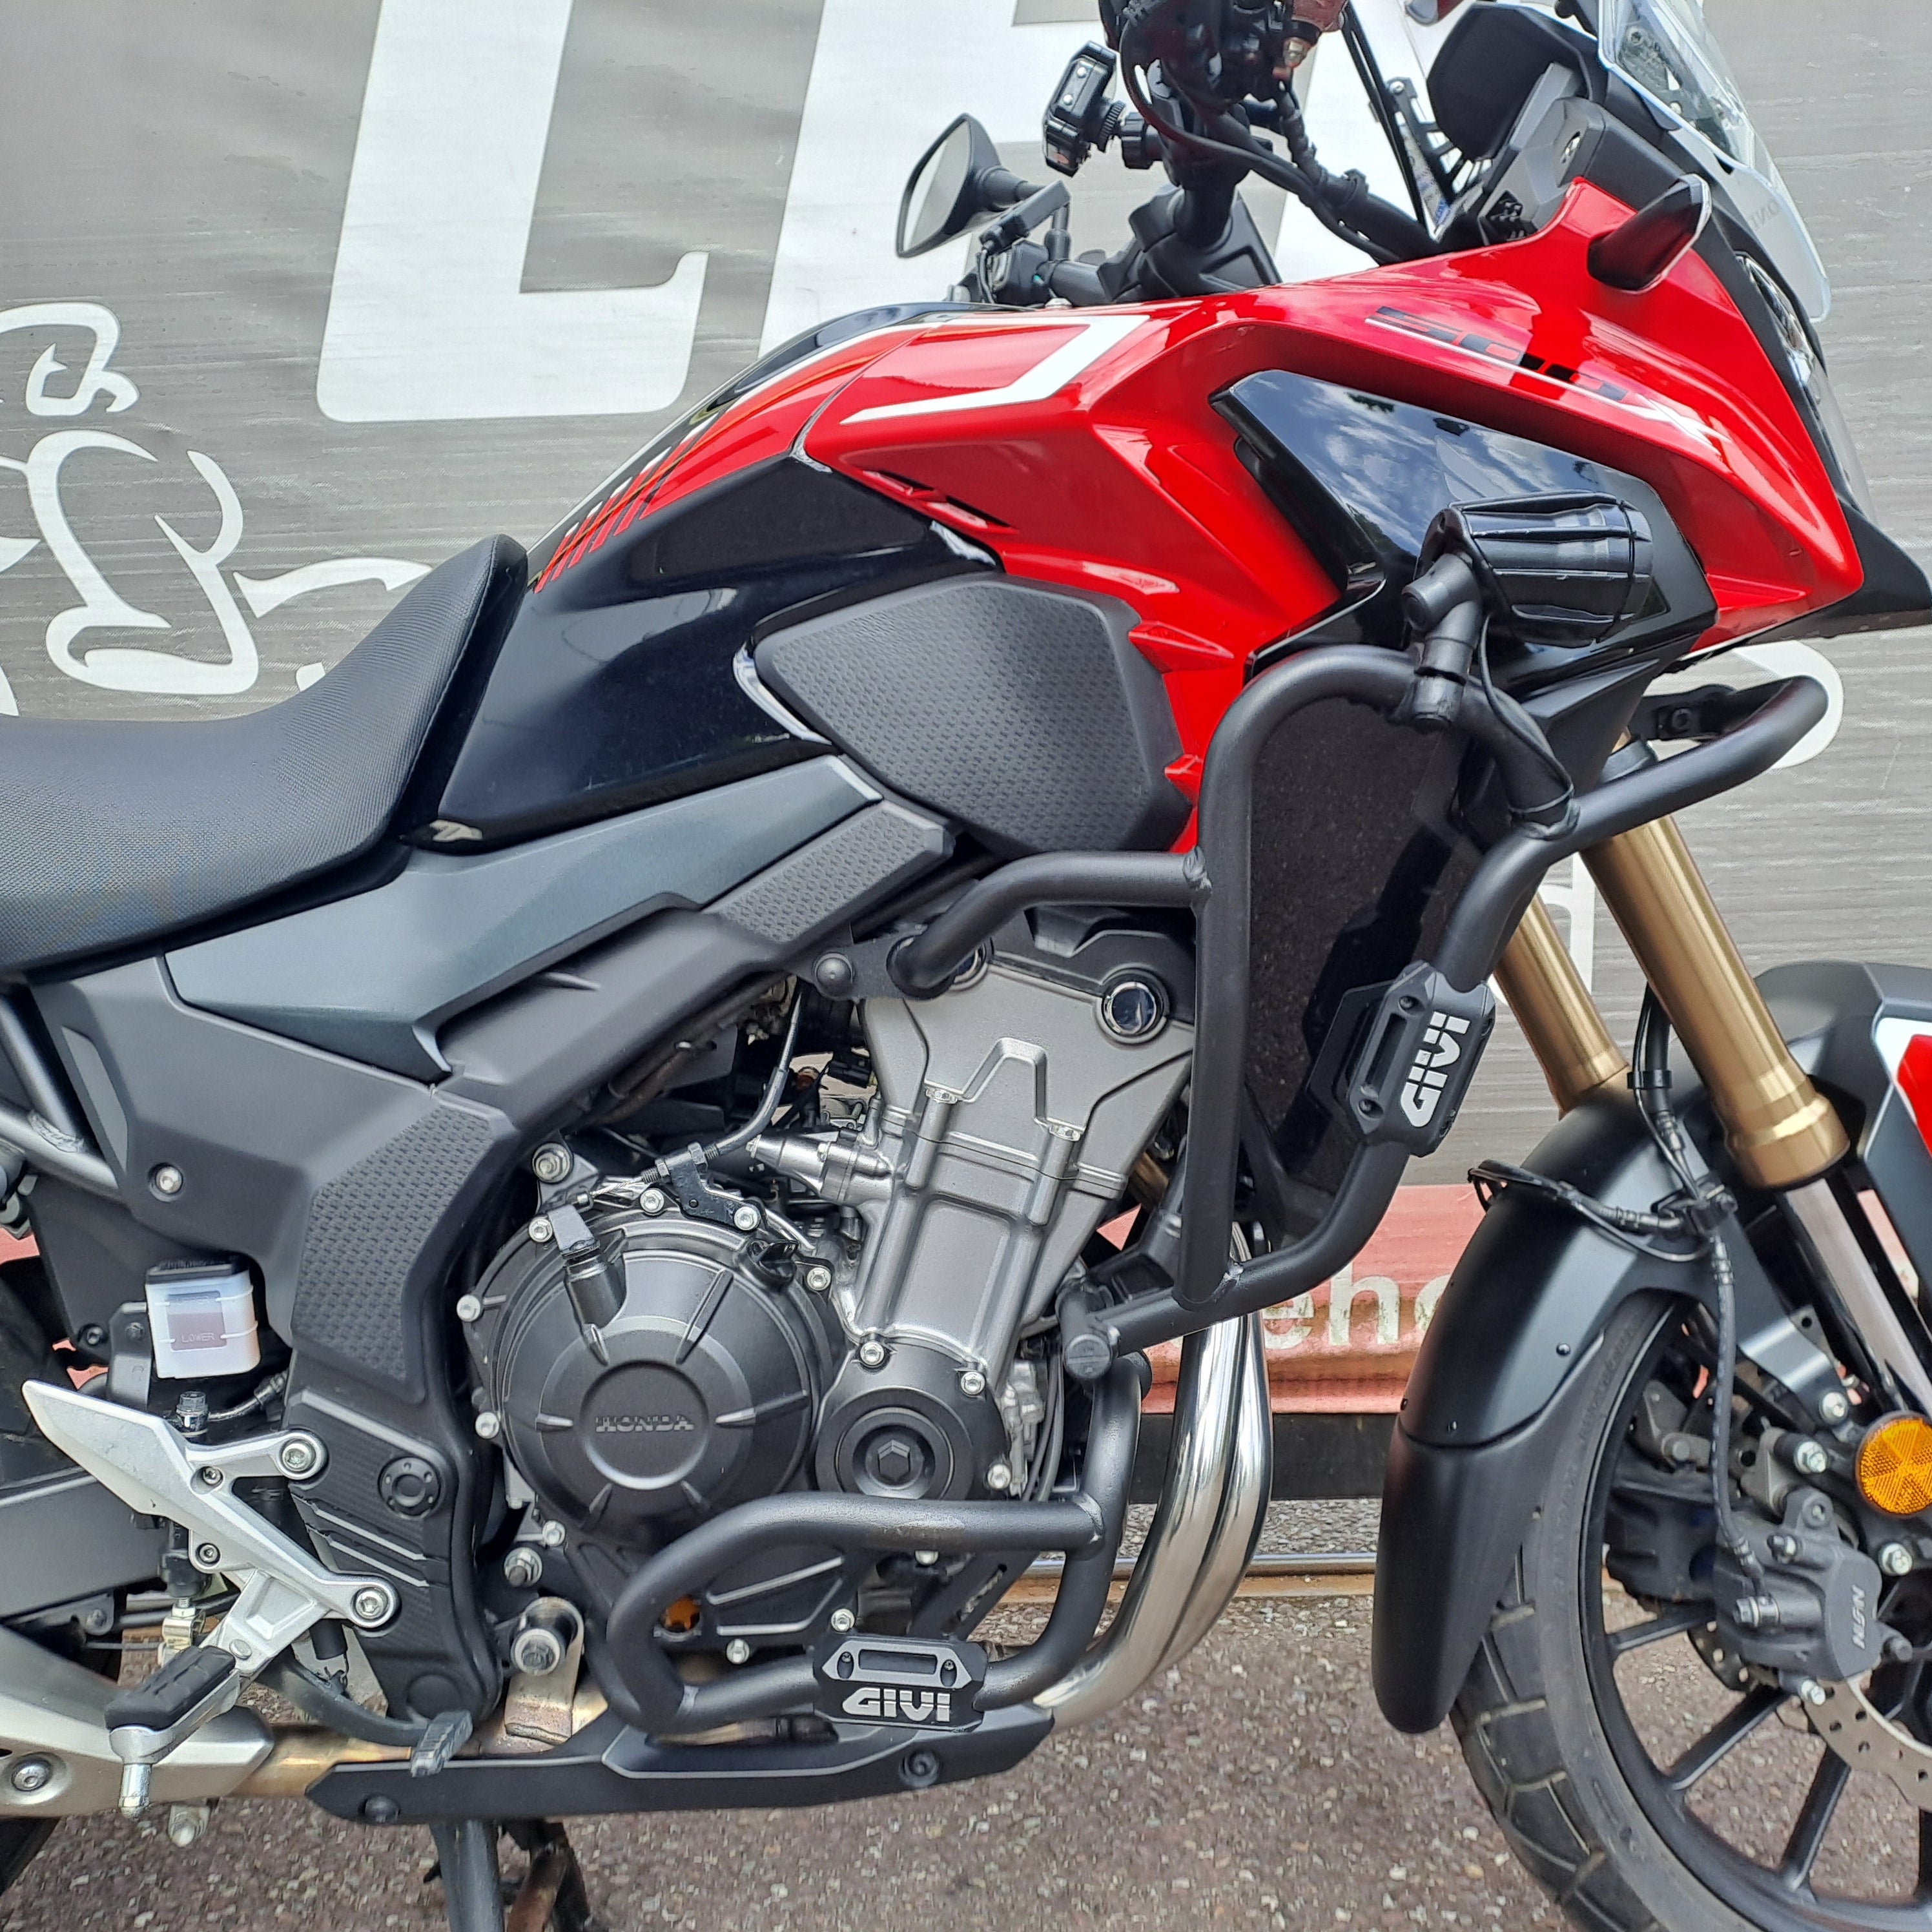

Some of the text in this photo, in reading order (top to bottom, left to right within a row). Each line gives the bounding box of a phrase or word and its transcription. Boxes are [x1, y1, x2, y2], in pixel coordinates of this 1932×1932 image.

[1400, 1011, 1470, 1127] GIVI
[181, 1332, 214, 1343] LOWER
[595, 1415, 695, 1433] HONDA
[842, 1687, 951, 1722] GIVI
